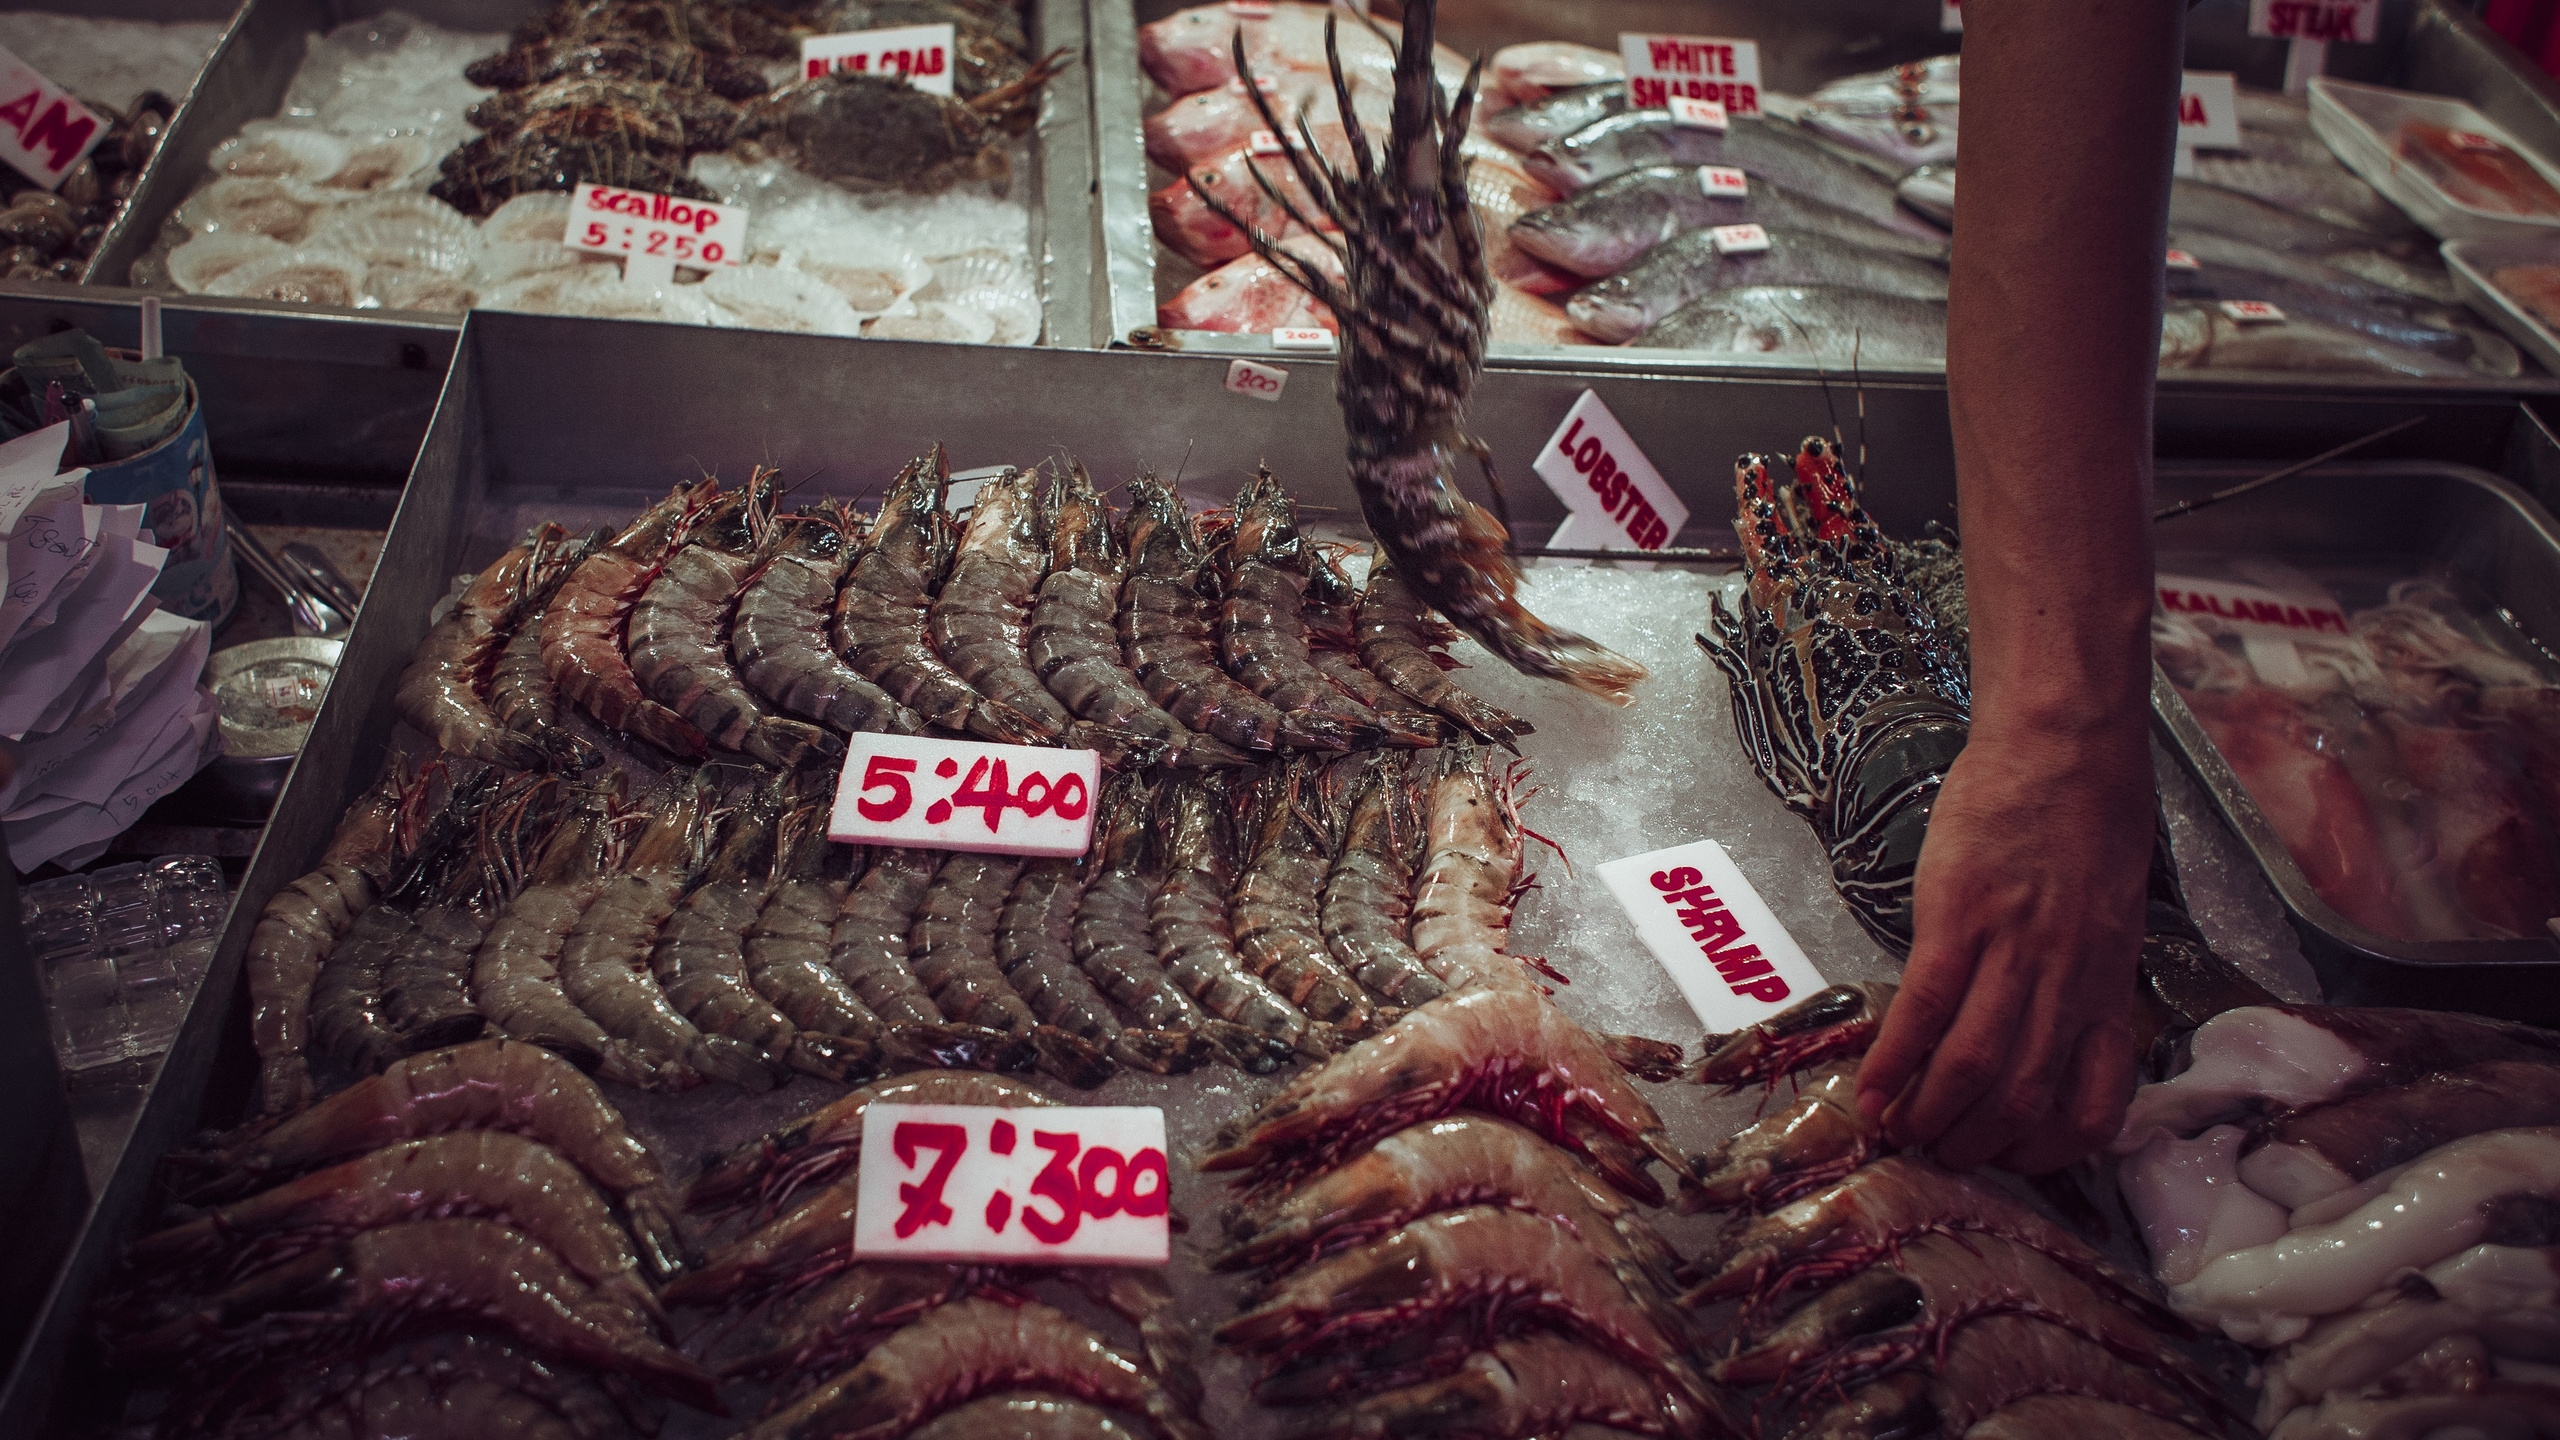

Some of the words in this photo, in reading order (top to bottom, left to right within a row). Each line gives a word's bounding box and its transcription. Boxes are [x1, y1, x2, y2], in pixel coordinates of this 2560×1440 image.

[1647, 40, 1736, 76] WHITE
[1284, 330, 1320, 340] 200
[1235, 367, 1279, 393] 200
[1558, 417, 1668, 550] LOBSTER
[856, 754, 1089, 833] 5:400
[893, 1117, 1168, 1244] 7:300
